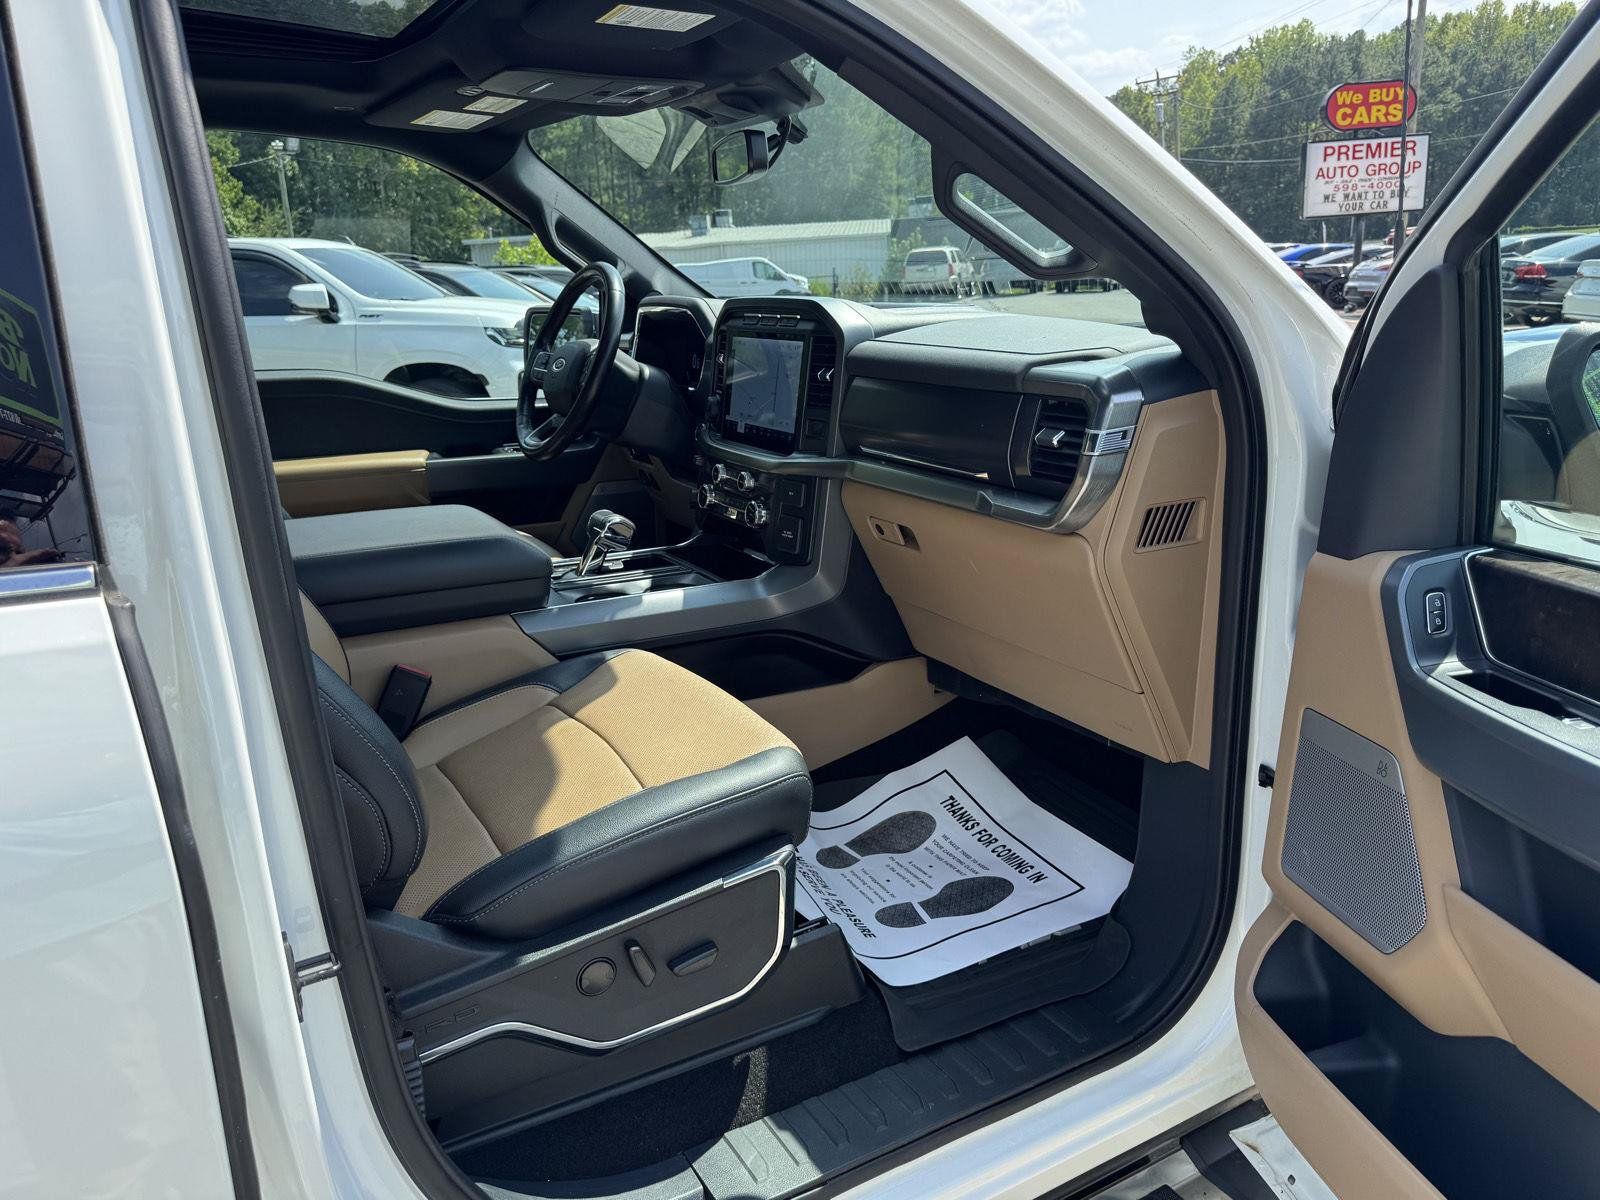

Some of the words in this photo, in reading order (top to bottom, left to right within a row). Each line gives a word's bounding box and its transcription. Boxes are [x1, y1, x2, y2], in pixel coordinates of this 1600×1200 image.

[1336, 90, 1363, 105] We
[1368, 87, 1405, 103] BUY
[1335, 103, 1404, 126] CARS
[1323, 140, 1417, 162] PREMIER
[1315, 164, 1359, 180] AUTO
[1365, 160, 1422, 177] GROUP
[1323, 193, 1337, 204] WE
[1343, 190, 1369, 202] WANT
[1373, 188, 1385, 199] TO
[1338, 202, 1364, 213] YOUR
[1370, 200, 1388, 210] CAR
[932, 839, 944, 850] YOUR
[940, 795, 980, 831] THANKS
[971, 828, 999, 848] FOR
[991, 844, 1035, 874] COMING
[1026, 870, 1048, 884] IN
[831, 898, 877, 939] PLEASURE
